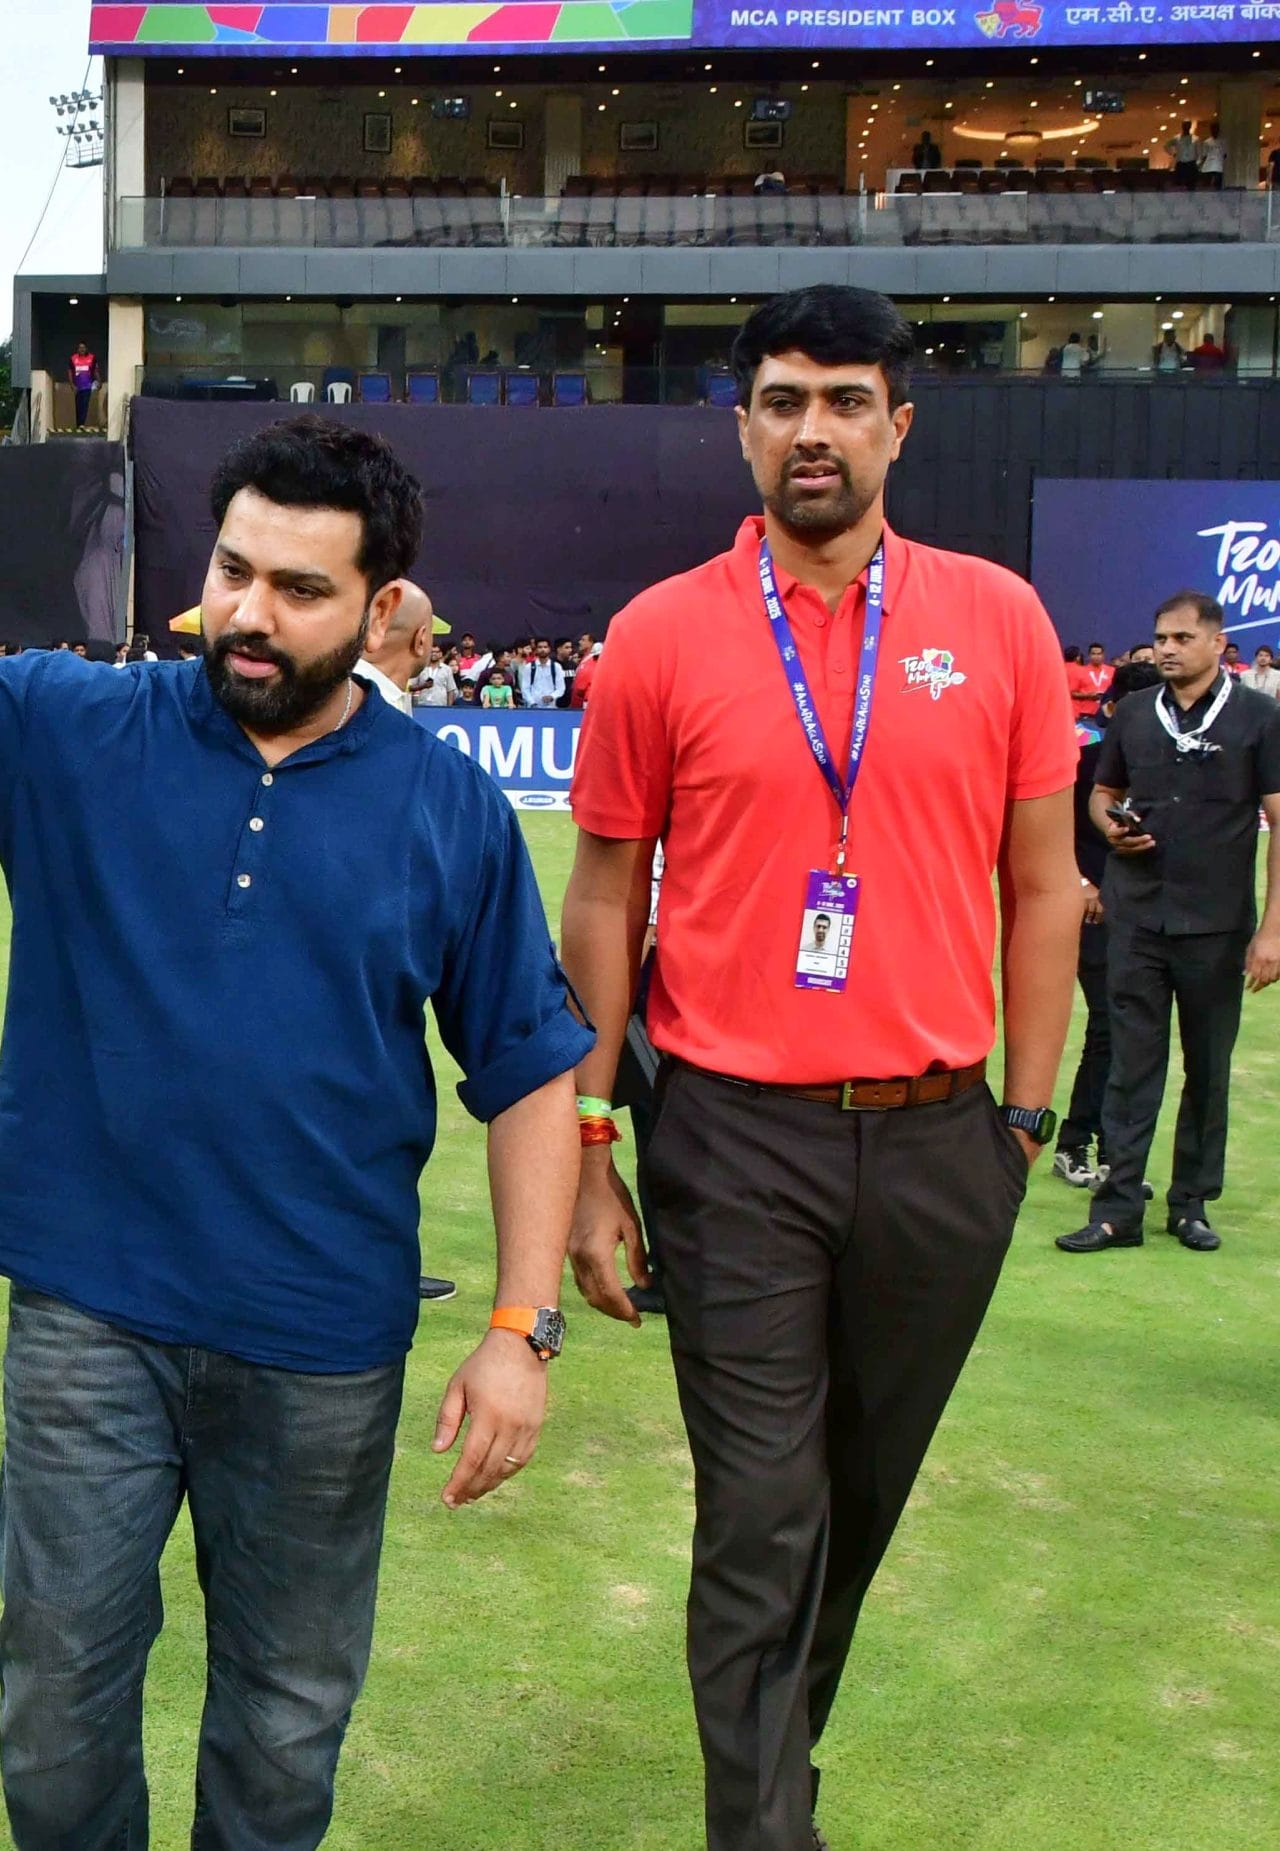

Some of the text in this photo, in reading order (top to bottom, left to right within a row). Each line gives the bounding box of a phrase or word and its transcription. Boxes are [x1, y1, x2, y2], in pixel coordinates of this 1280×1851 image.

[730, 9, 956, 26] MCA PRESIDENT BOX
